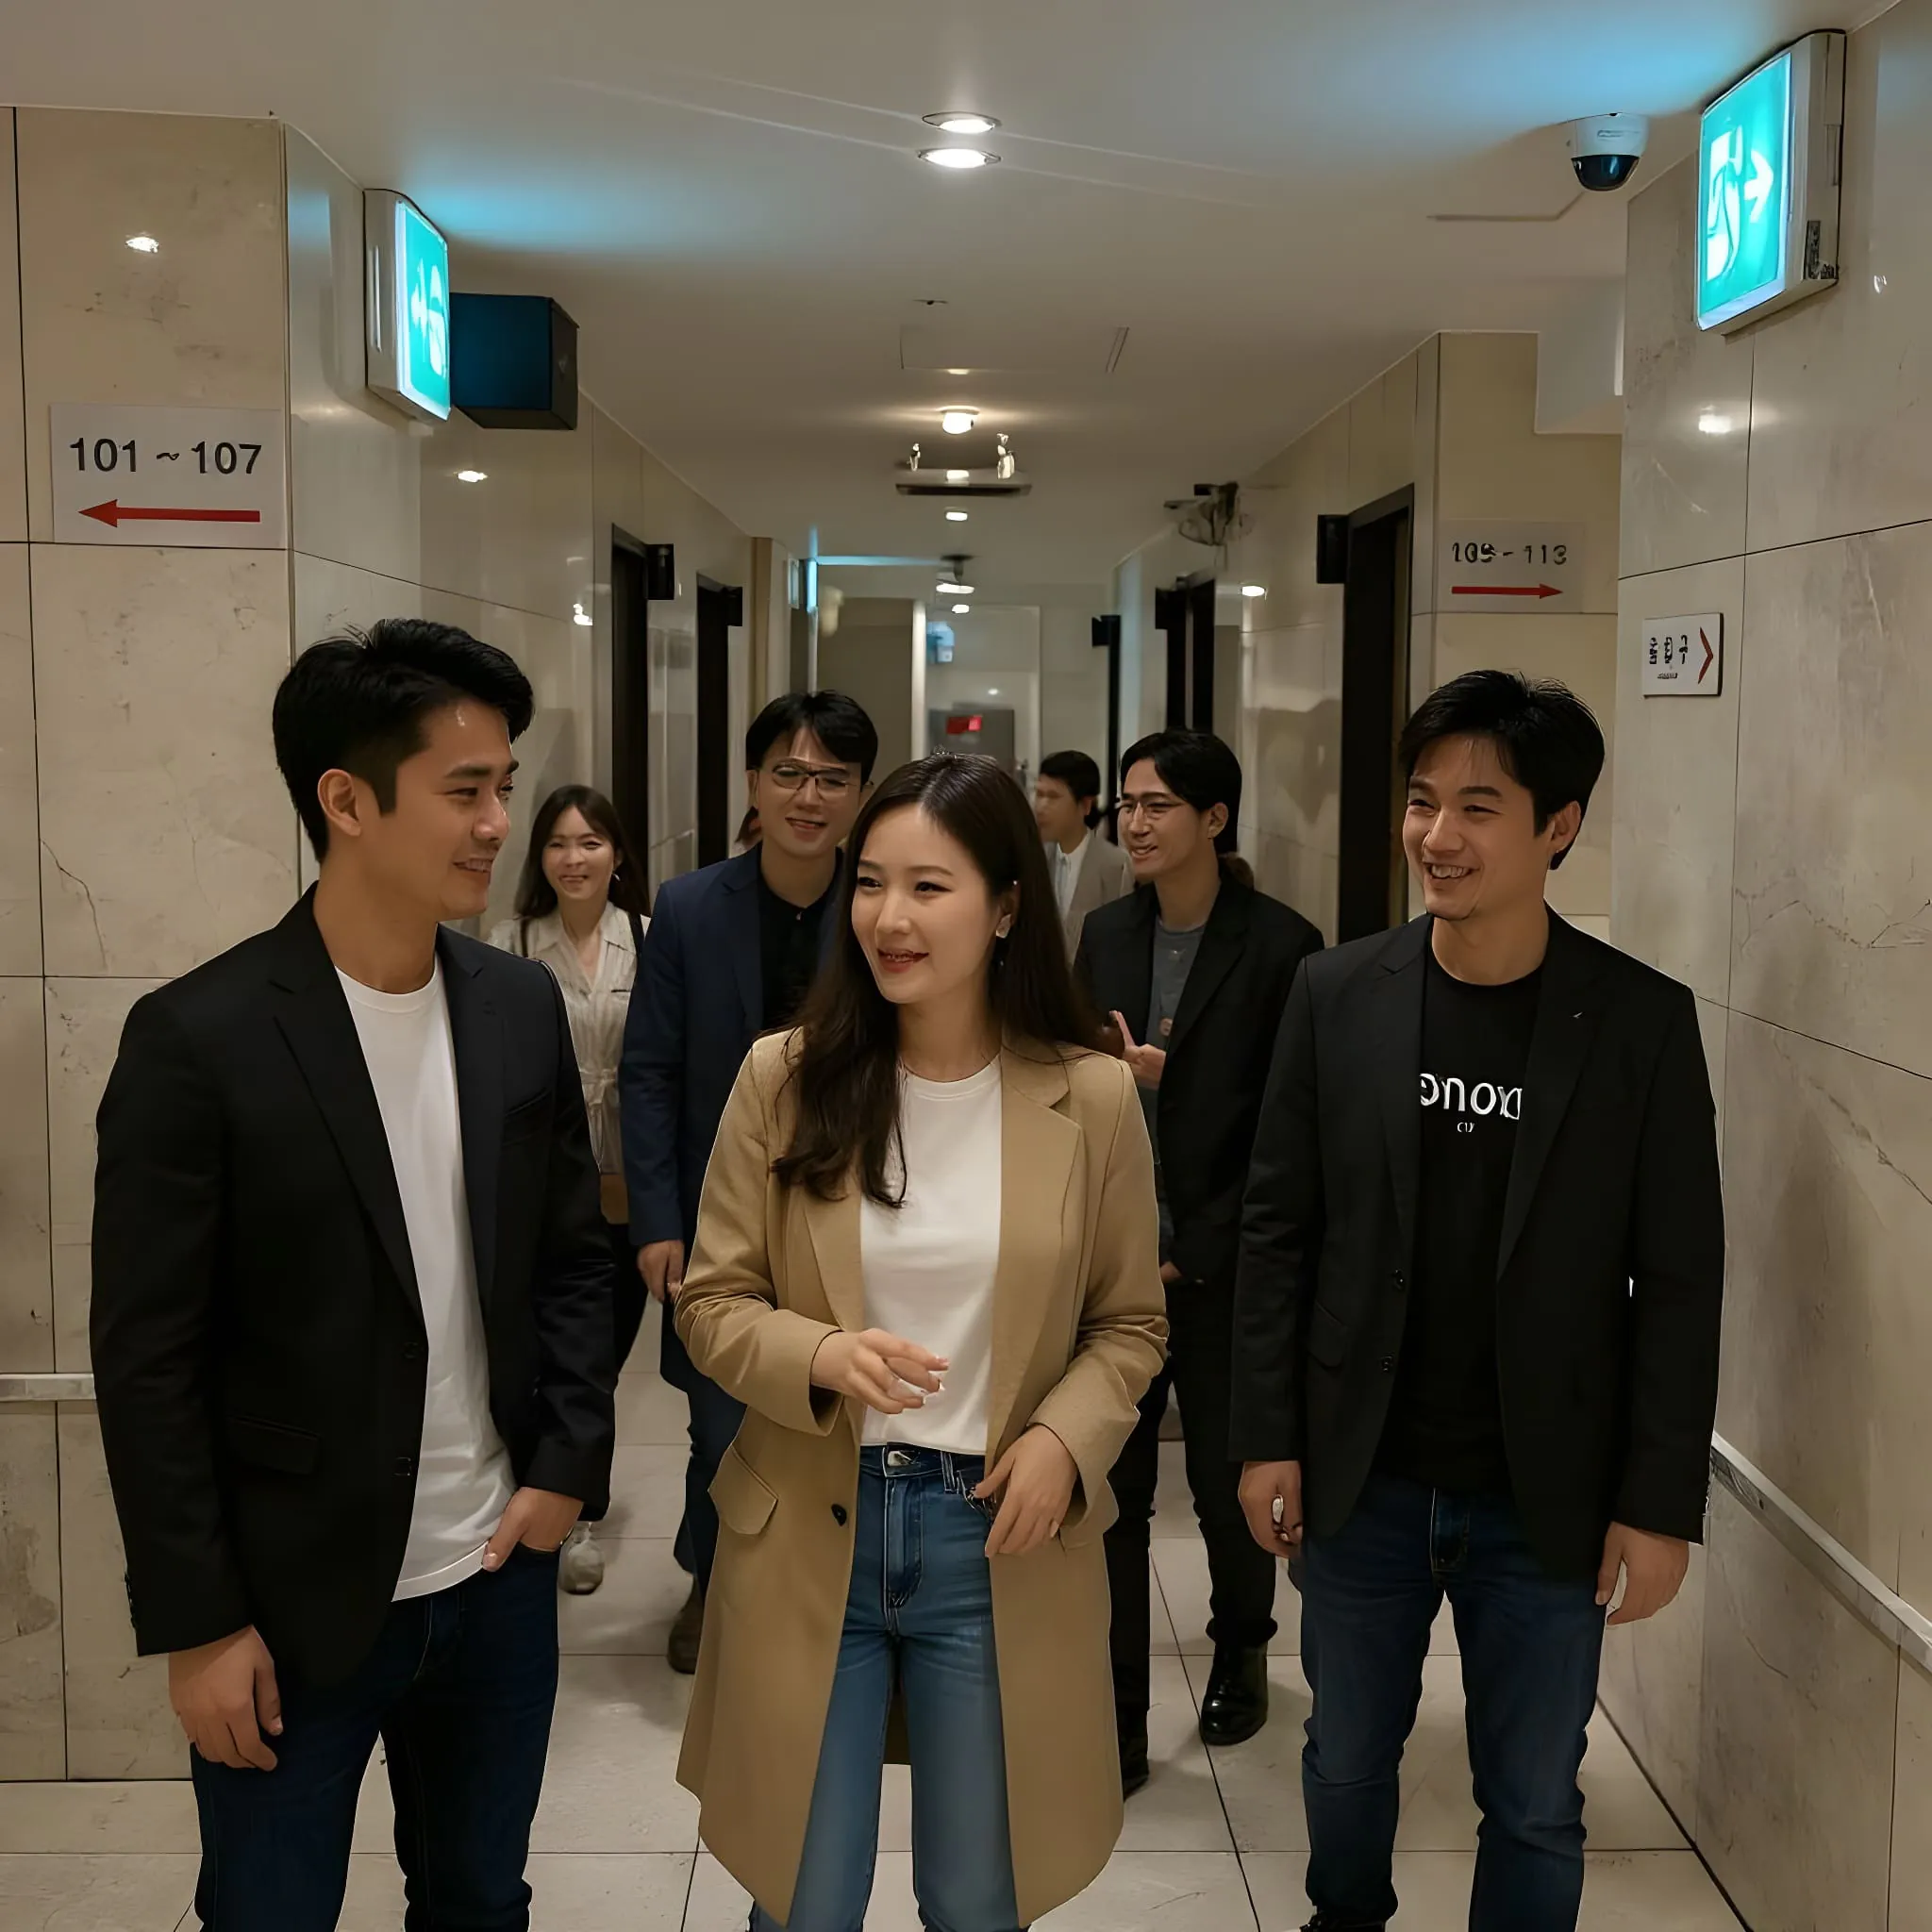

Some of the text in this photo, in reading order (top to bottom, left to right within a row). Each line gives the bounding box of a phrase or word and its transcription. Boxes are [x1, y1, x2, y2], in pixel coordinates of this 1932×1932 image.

[70, 437, 137, 473] 101
[191, 441, 262, 475] 107
[1524, 543, 1568, 566] 113
